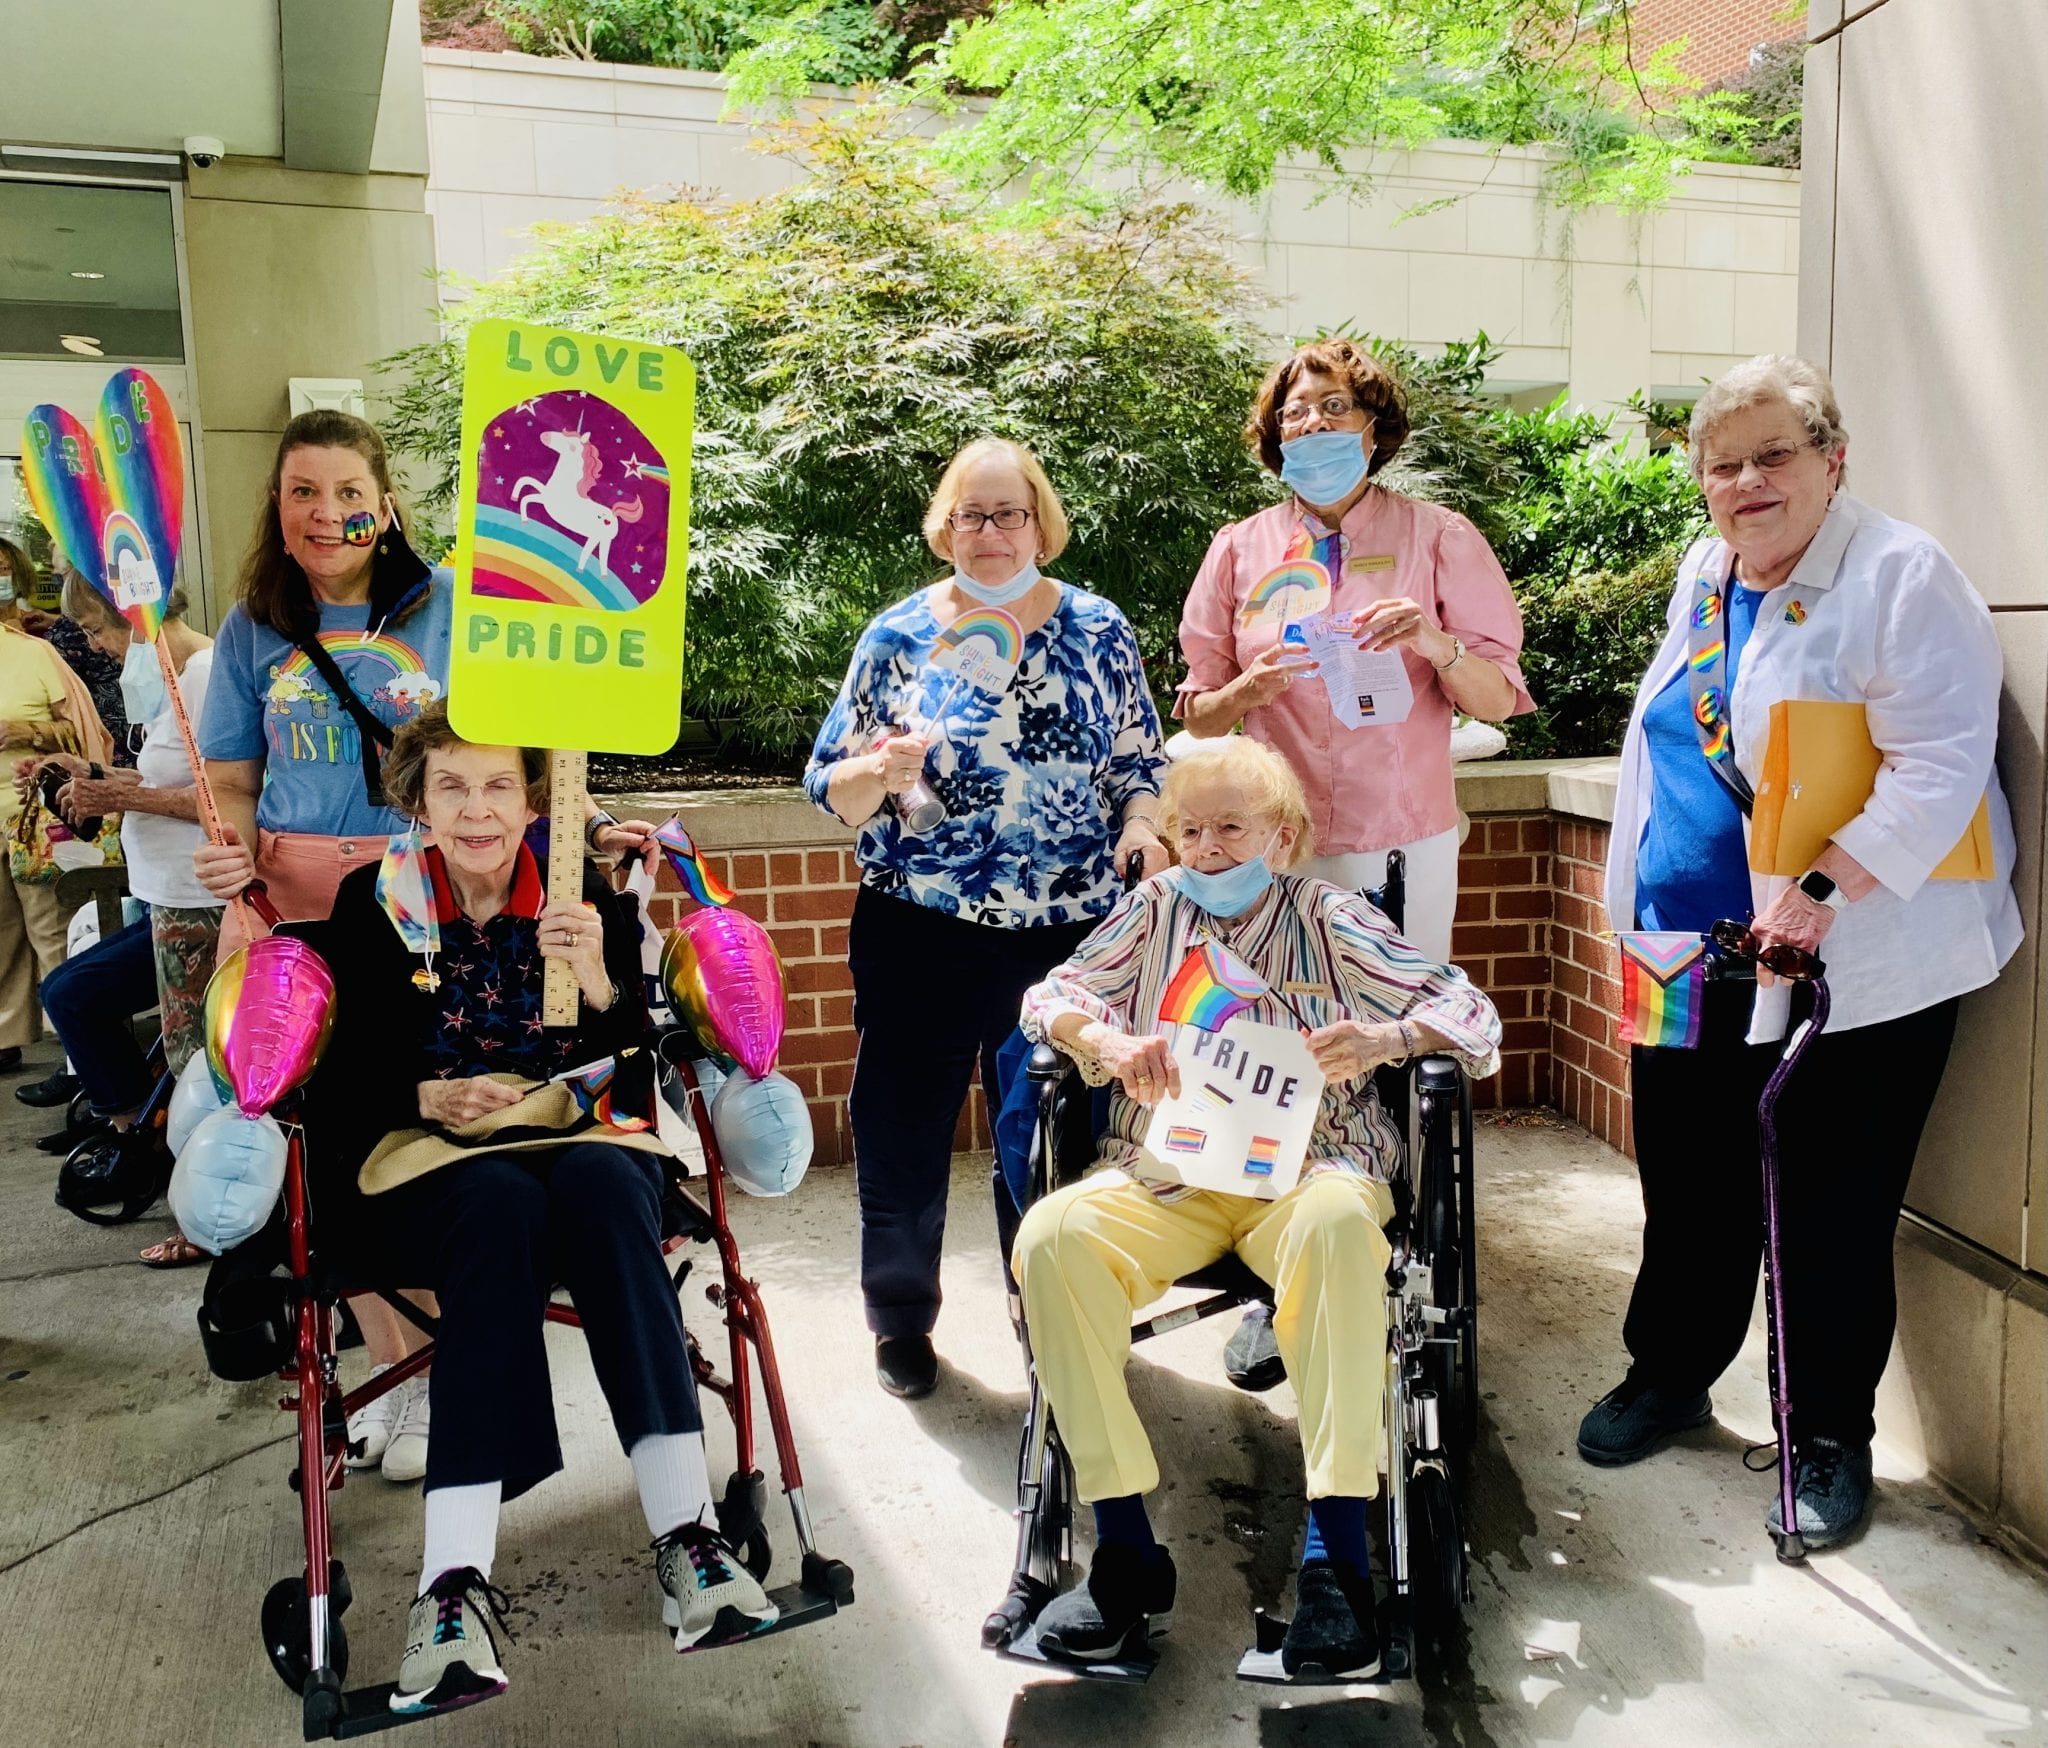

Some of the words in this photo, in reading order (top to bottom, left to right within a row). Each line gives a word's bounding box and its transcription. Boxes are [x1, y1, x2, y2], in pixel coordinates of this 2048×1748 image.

[505, 330, 664, 392] LOVE
[31, 379, 151, 483] PRIDE
[468, 614, 647, 668] PRIDE
[323, 724, 360, 765] FO
[1193, 1029, 1299, 1108] PRIDE
